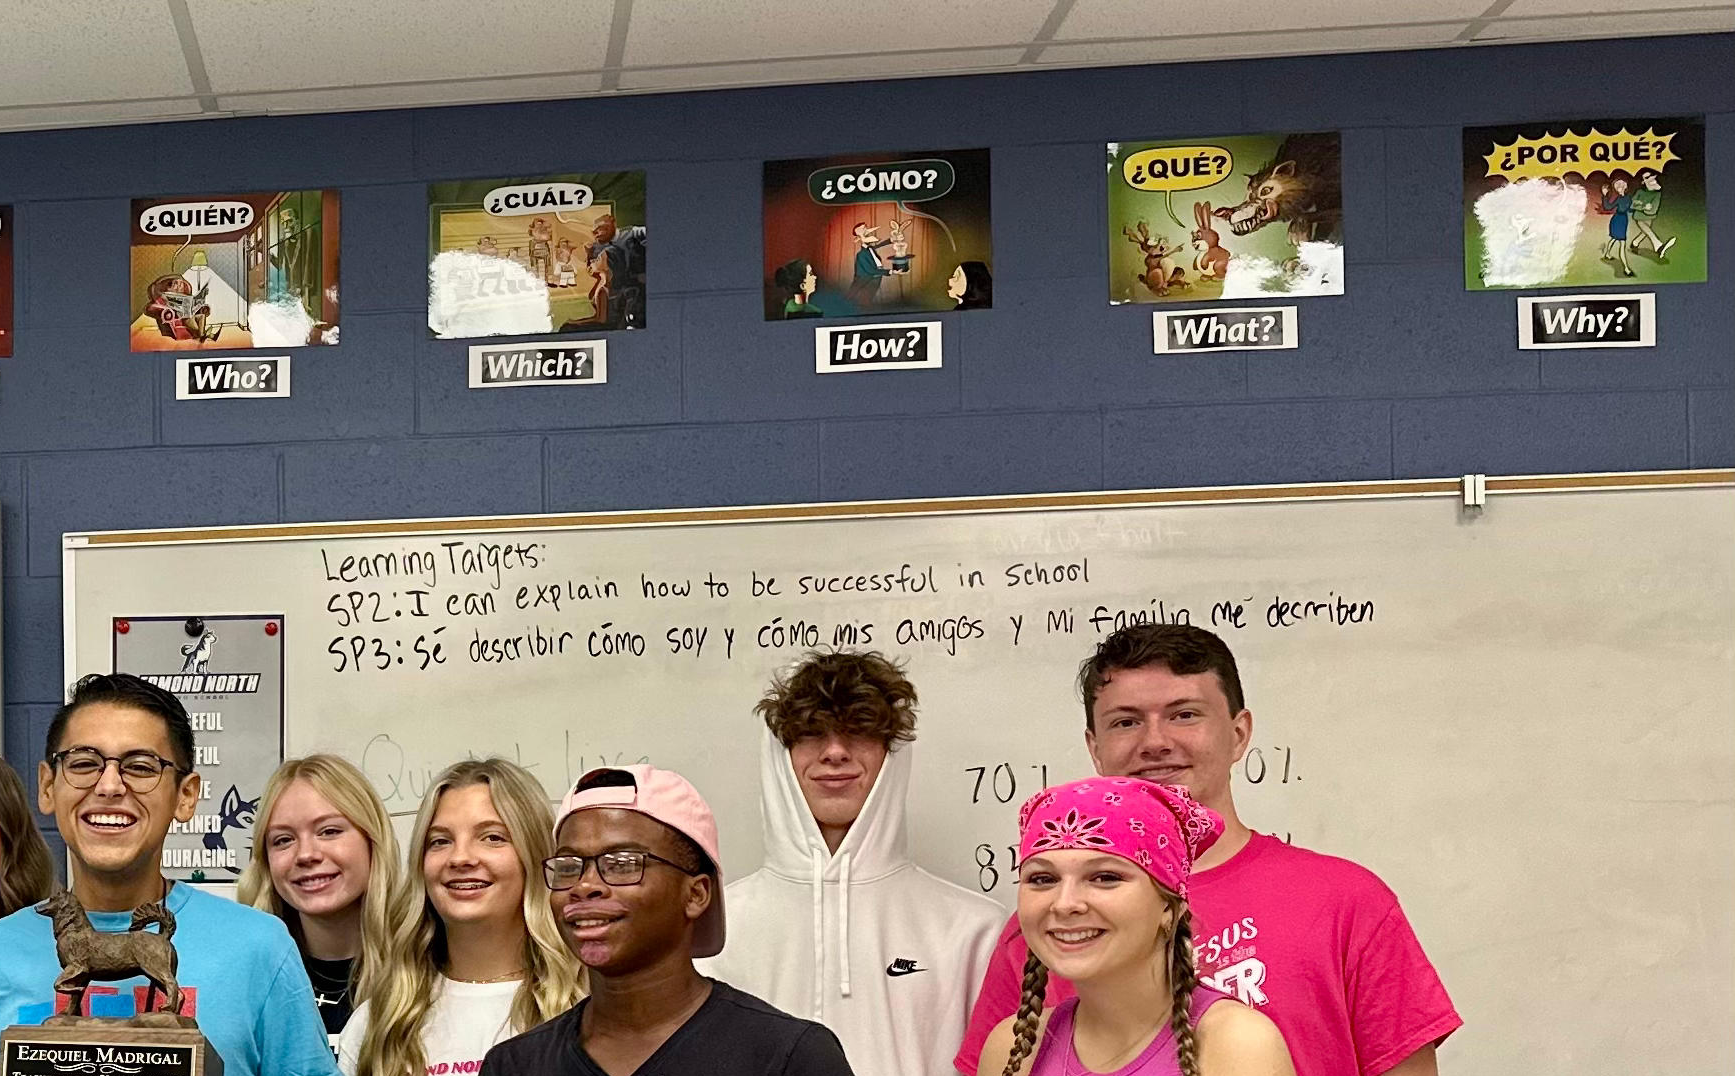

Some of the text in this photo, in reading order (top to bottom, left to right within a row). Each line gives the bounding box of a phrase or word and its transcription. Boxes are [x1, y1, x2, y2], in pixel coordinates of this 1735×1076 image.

[1131, 153, 1228, 185] ¿QUÉ?
[1500, 136, 1667, 172] ¿POR QUÉ?
[821, 166, 938, 200] ¿CÓMO?
[490, 187, 587, 214] ¿CUÁL?
[145, 204, 250, 232] ¿QUIÉN?
[1173, 315, 1276, 346] What?
[1542, 306, 1629, 338] Why?
[835, 330, 920, 361] How?
[194, 363, 272, 392] Who?
[487, 353, 587, 379] Which?
[321, 541, 546, 590] Learning Targets:
[446, 592, 496, 616] can
[516, 576, 618, 612] explain
[641, 573, 691, 598] how
[704, 572, 729, 598] to
[752, 571, 782, 597] be
[799, 564, 938, 595] successful
[958, 562, 985, 588] in
[327, 635, 404, 673] SP3:
[469, 625, 572, 663] describir
[896, 615, 985, 656] amigos
[141, 674, 259, 693] MOND NORTH
[893, 957, 918, 970] NIKE
